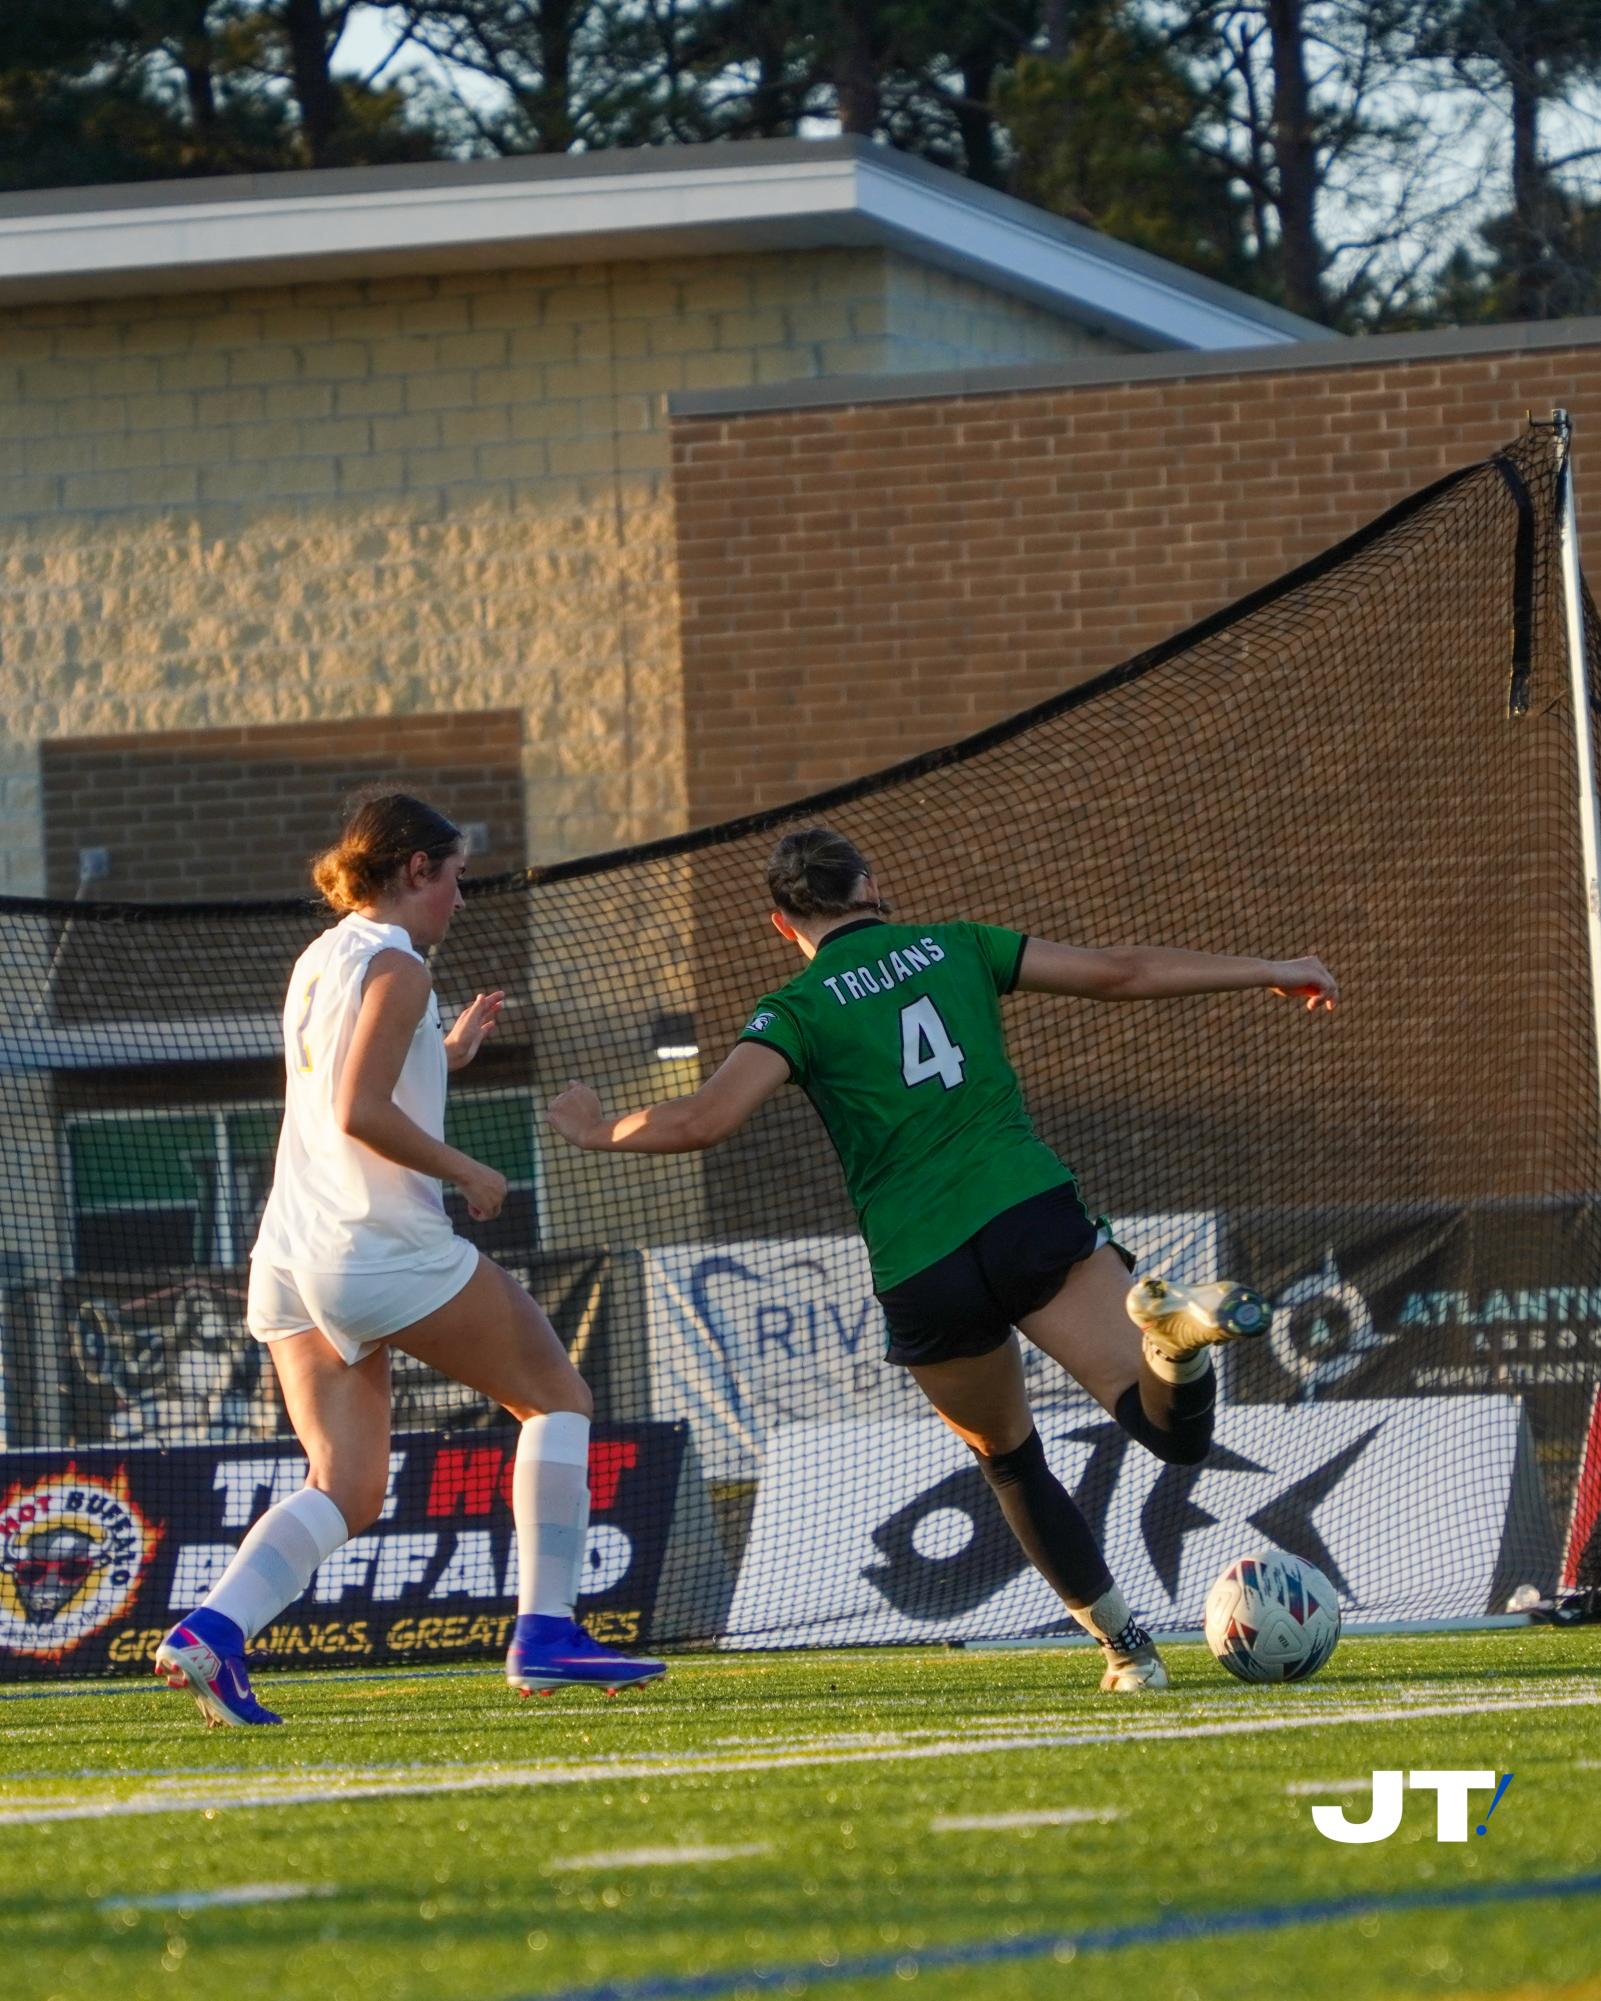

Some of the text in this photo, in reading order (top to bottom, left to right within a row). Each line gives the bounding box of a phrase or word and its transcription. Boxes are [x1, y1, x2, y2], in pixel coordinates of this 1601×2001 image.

[822, 937, 946, 1006] TROJANS
[899, 993, 966, 1091] 4
[755, 1299, 873, 1360] RIV
[427, 1441, 638, 1517] HT
[65, 1491, 137, 1586] BUFFALO
[168, 1524, 633, 1611] BFFAO
